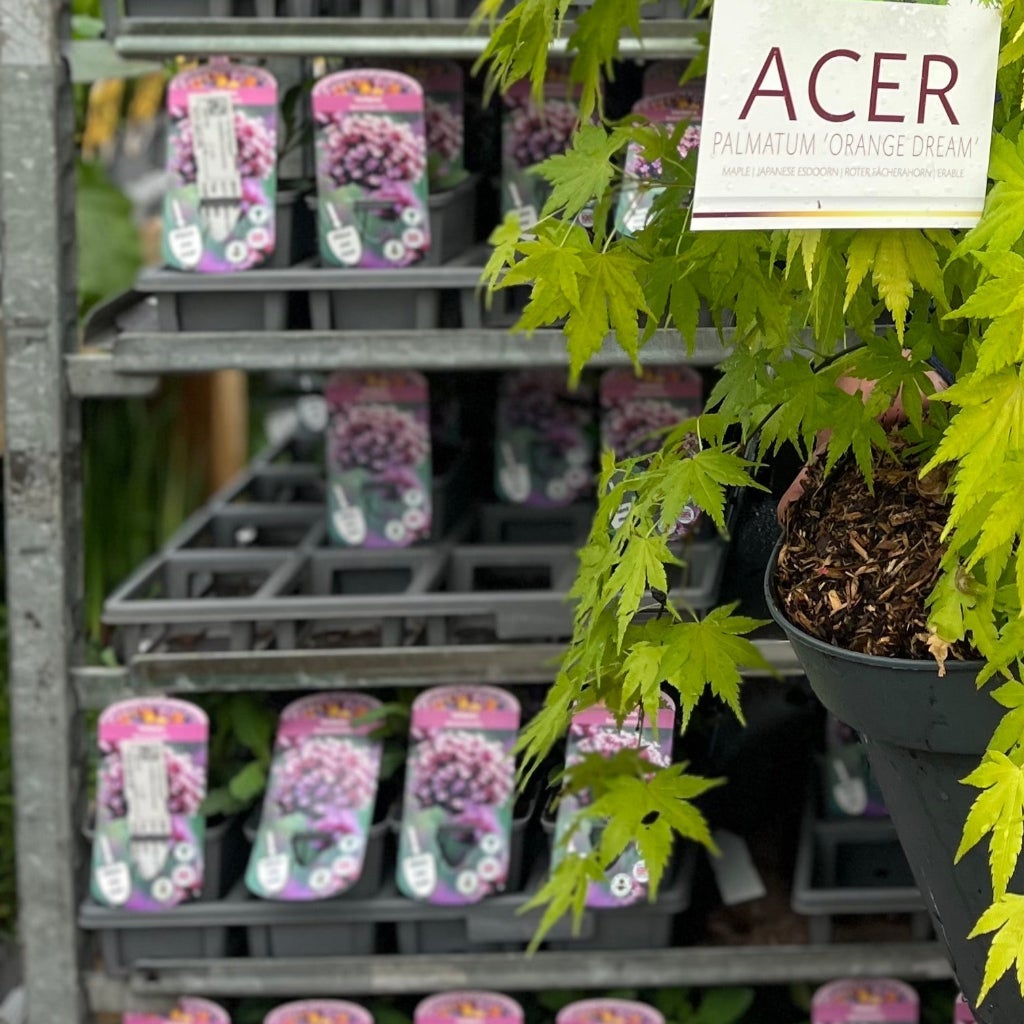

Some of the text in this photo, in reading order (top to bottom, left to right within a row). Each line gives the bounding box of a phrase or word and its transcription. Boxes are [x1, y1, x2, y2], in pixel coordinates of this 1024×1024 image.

[738, 47, 960, 125] ACER
[712, 131, 815, 156] PALMATUM
[722, 166, 751, 177] MAPLE
[757, 166, 796, 177] JAPANESE
[798, 166, 839, 177] ESDOORN
